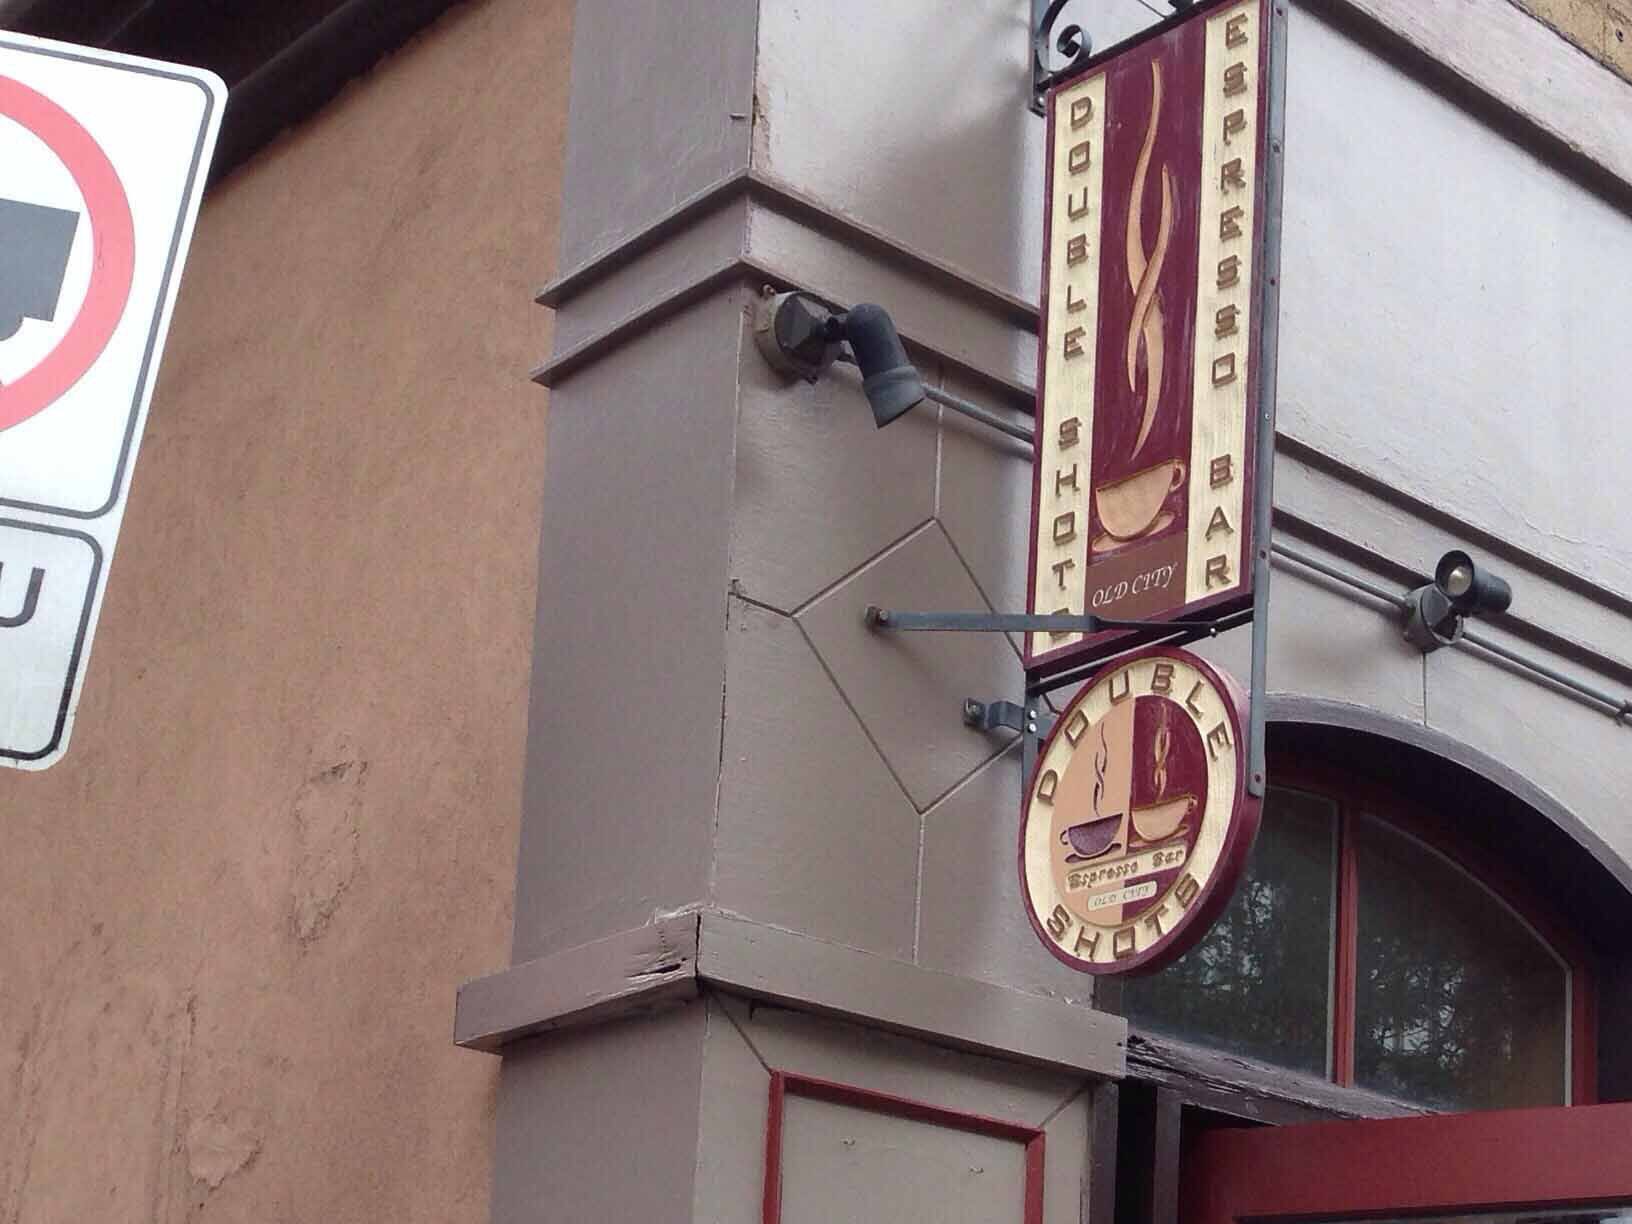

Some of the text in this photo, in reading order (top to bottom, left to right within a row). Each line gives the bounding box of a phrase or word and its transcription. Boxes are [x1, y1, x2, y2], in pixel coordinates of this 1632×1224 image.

[1064, 96, 1093, 361] DOUBLE
[1205, 13, 1249, 587] ESPRESSO BAR
[1092, 561, 1178, 608] OLD CITY
[1037, 662, 1233, 806] DOUBLE
[1047, 872, 1201, 961] SHOTS
[1068, 849, 1184, 888] Espresso Bar
